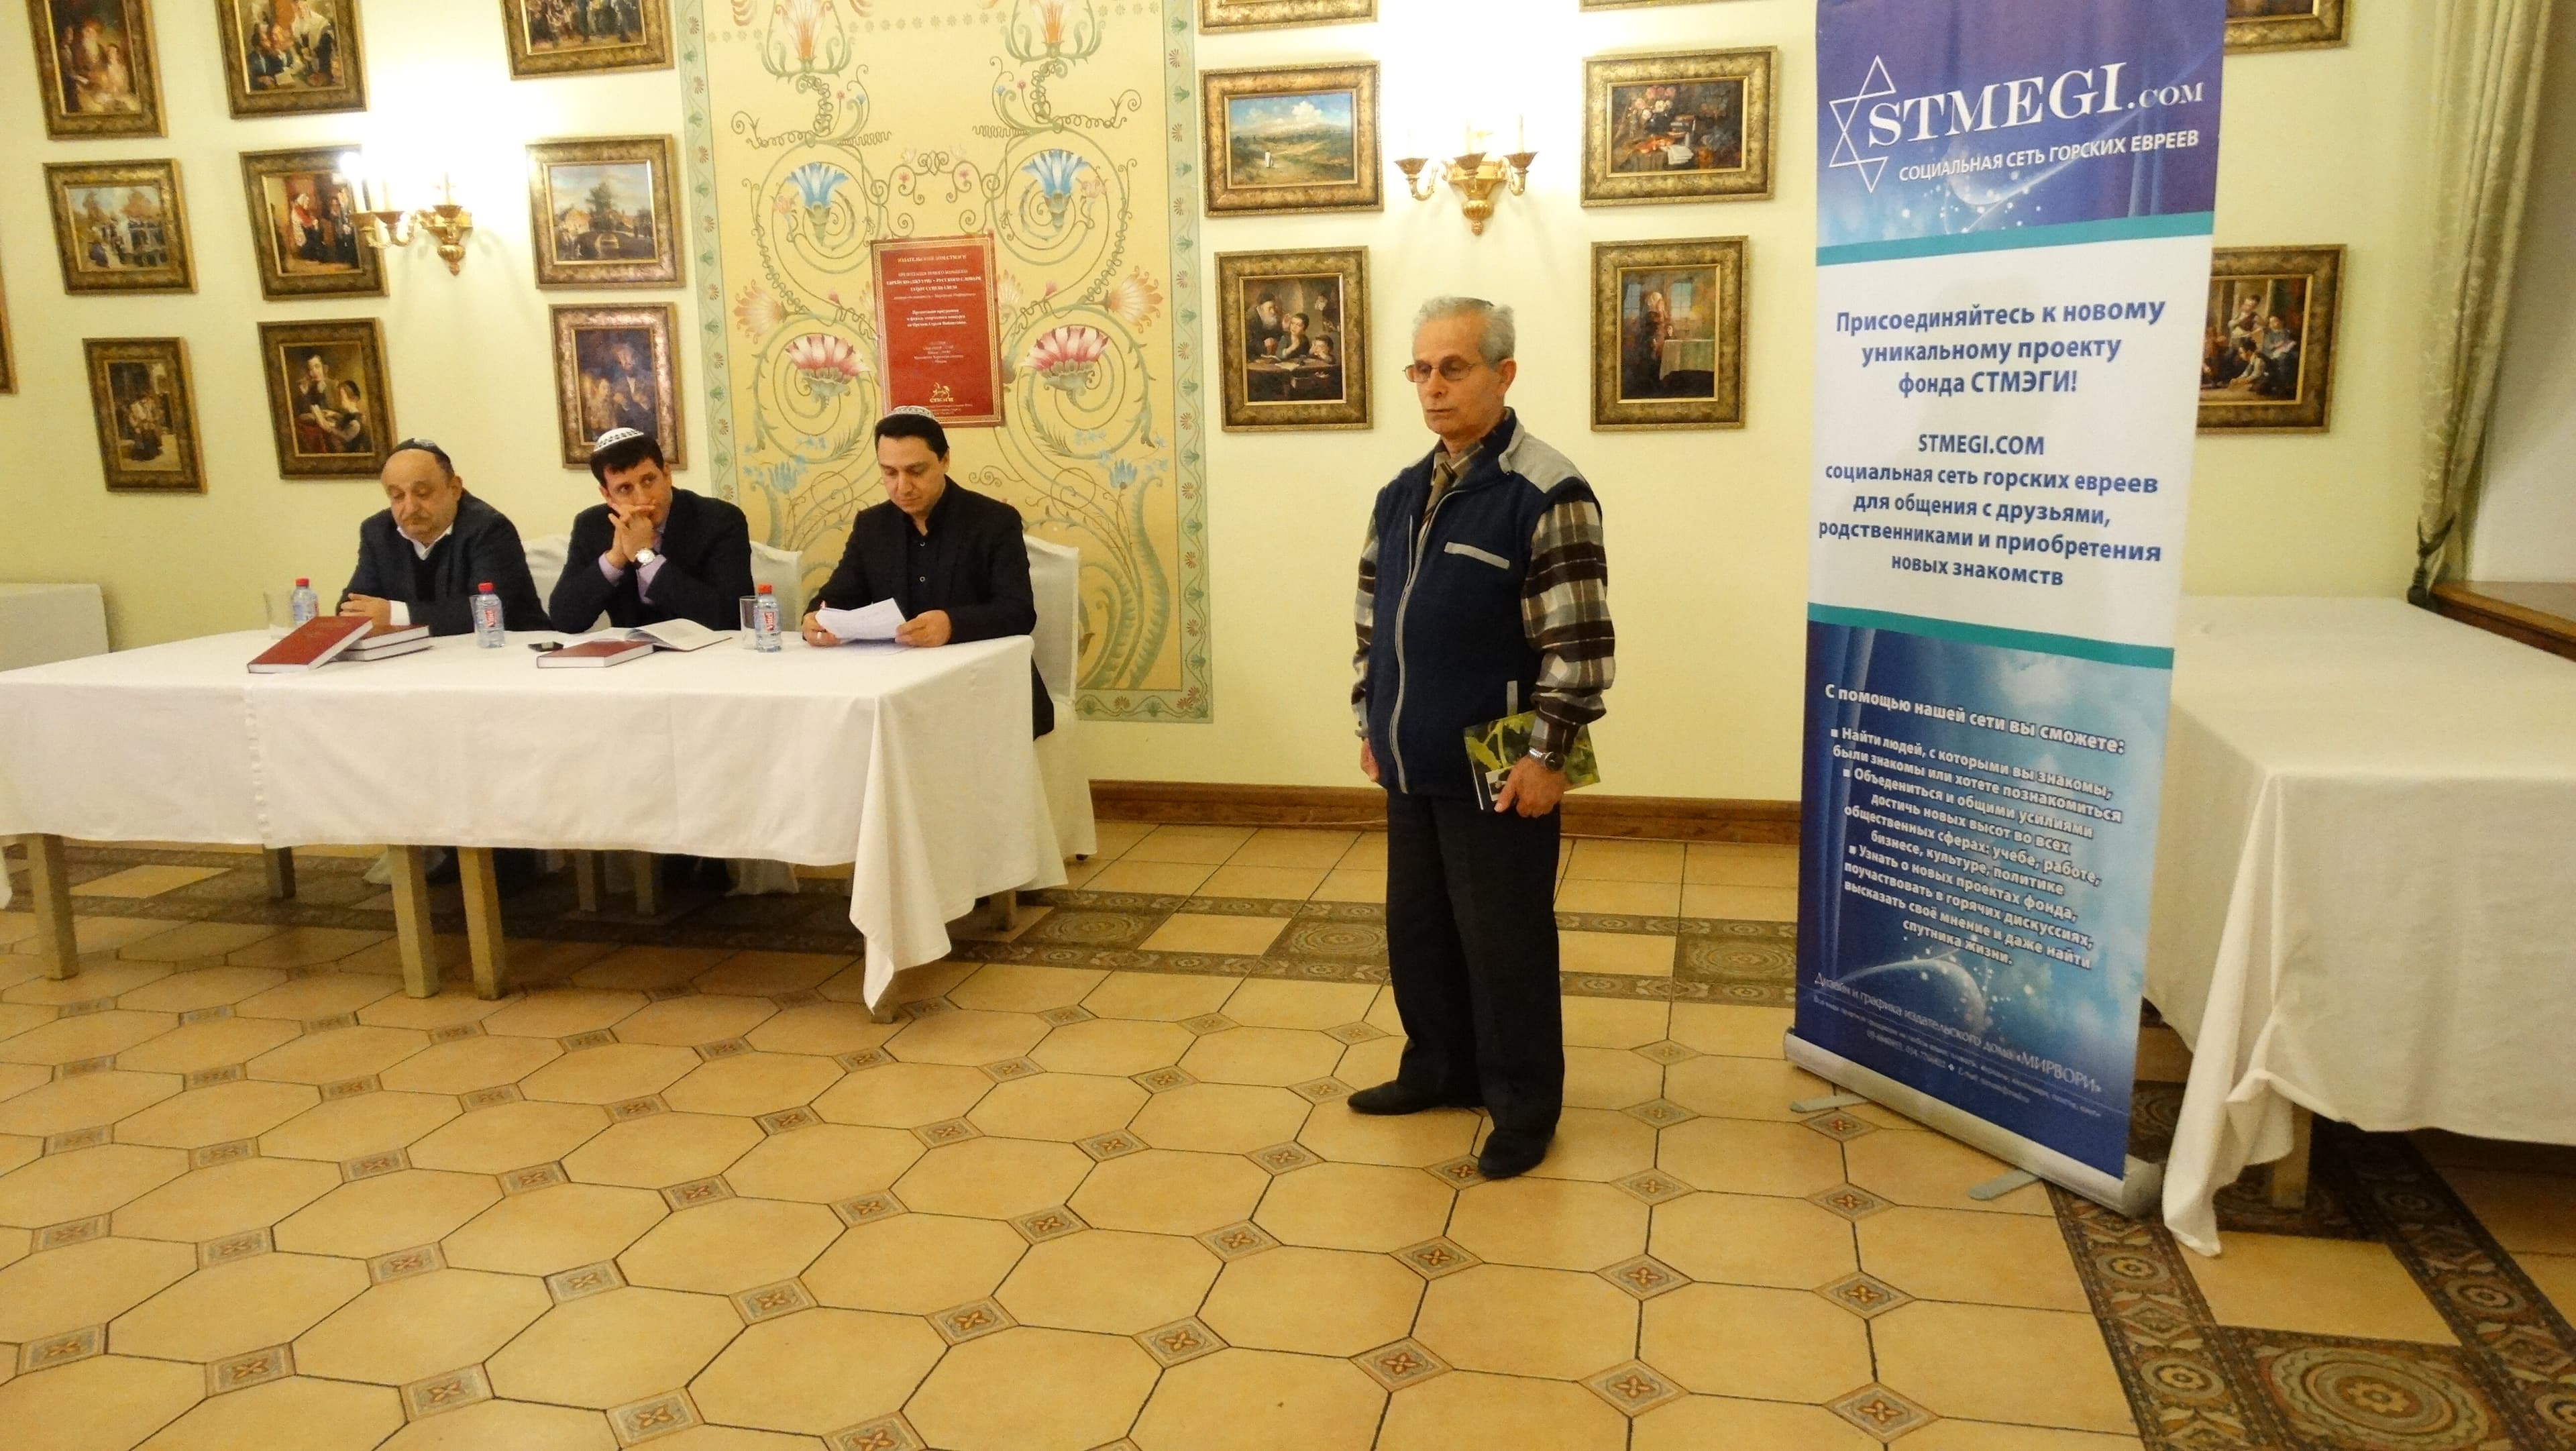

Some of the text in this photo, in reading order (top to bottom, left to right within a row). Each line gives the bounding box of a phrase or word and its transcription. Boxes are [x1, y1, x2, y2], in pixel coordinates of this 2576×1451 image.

[1899, 129, 2199, 182] СОЦИАЛЬНАЯ СЕТЬ ГОРСКИХ ЕВРЕЕВ
[1837, 301, 2165, 336] Присоединяйтесь к новому
[1862, 337, 2121, 368] уникальному проекту
[1899, 370, 2076, 398] фонда СТМЭГИ!
[1919, 434, 2045, 455] STMEGI.COM
[1825, 464, 2158, 495] социальная сеть горских евреев
[1854, 495, 2111, 527] для общения с друзьями,
[1819, 522, 2161, 561] родственниками и приобретения
[1892, 556, 2063, 586] новых знакомств
[1825, 684, 2125, 754] С помощью нашей сети вы сможете:
[1833, 745, 2122, 822] были знакомы или хотете познакомиться
[1841, 728, 2112, 799] Найти людей, с которыми вы знакомы,
[1872, 794, 2070, 855] достичь новых высот во всех
[1945, 792, 1954, 803] и
[1957, 795, 2015, 820] общими
[2019, 810, 2093, 839] усилиями
[1844, 806, 2102, 886] общественных сферах: учебе, работе,
[1871, 830, 2063, 896] бизнесе, культуре, политике
[1844, 862, 2094, 948] поучаствовать в горячих дискуссиях,
[1859, 845, 2077, 922] Узнать о новых проектах фонда,
[1844, 880, 2091, 970] высказать своё мнение и даже найти
[1902, 918, 2012, 965] спутника жизни.
[1861, 992, 1902, 1016] графика
